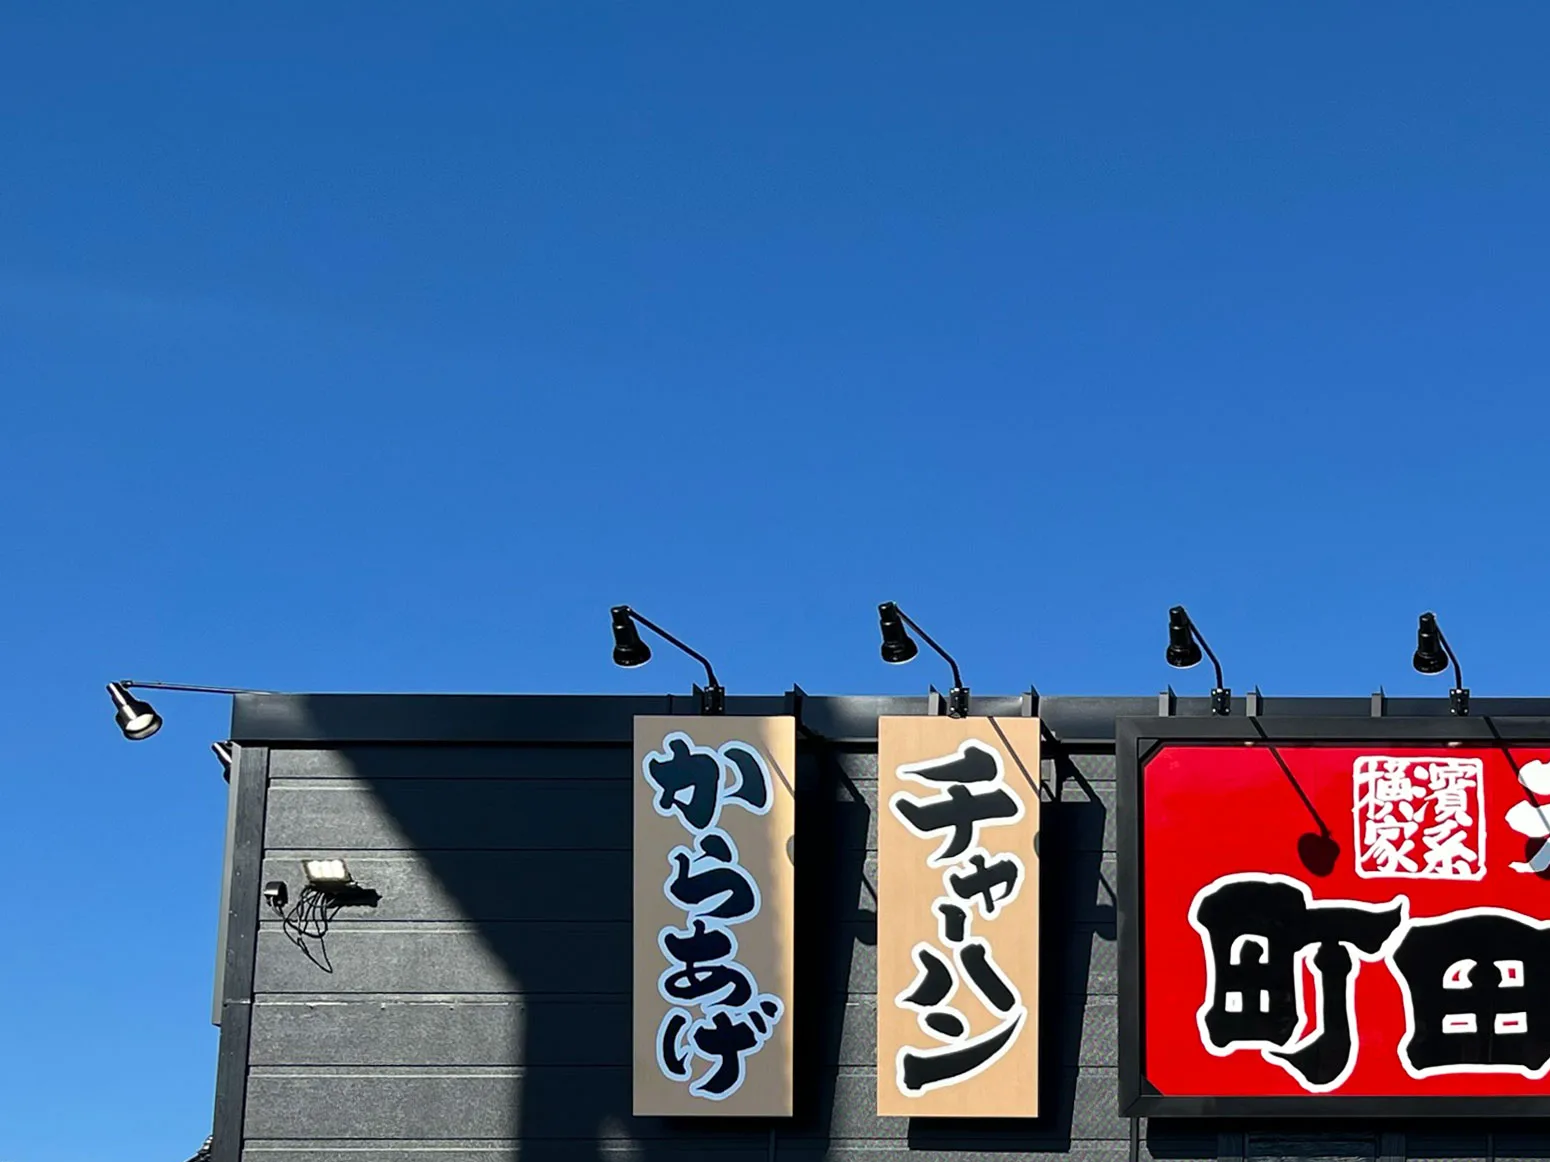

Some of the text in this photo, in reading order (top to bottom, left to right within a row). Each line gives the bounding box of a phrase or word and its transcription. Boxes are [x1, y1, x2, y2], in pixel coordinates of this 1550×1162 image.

[643, 732, 782, 1099] からあげ
[892, 741, 1027, 1096] チャーハン
